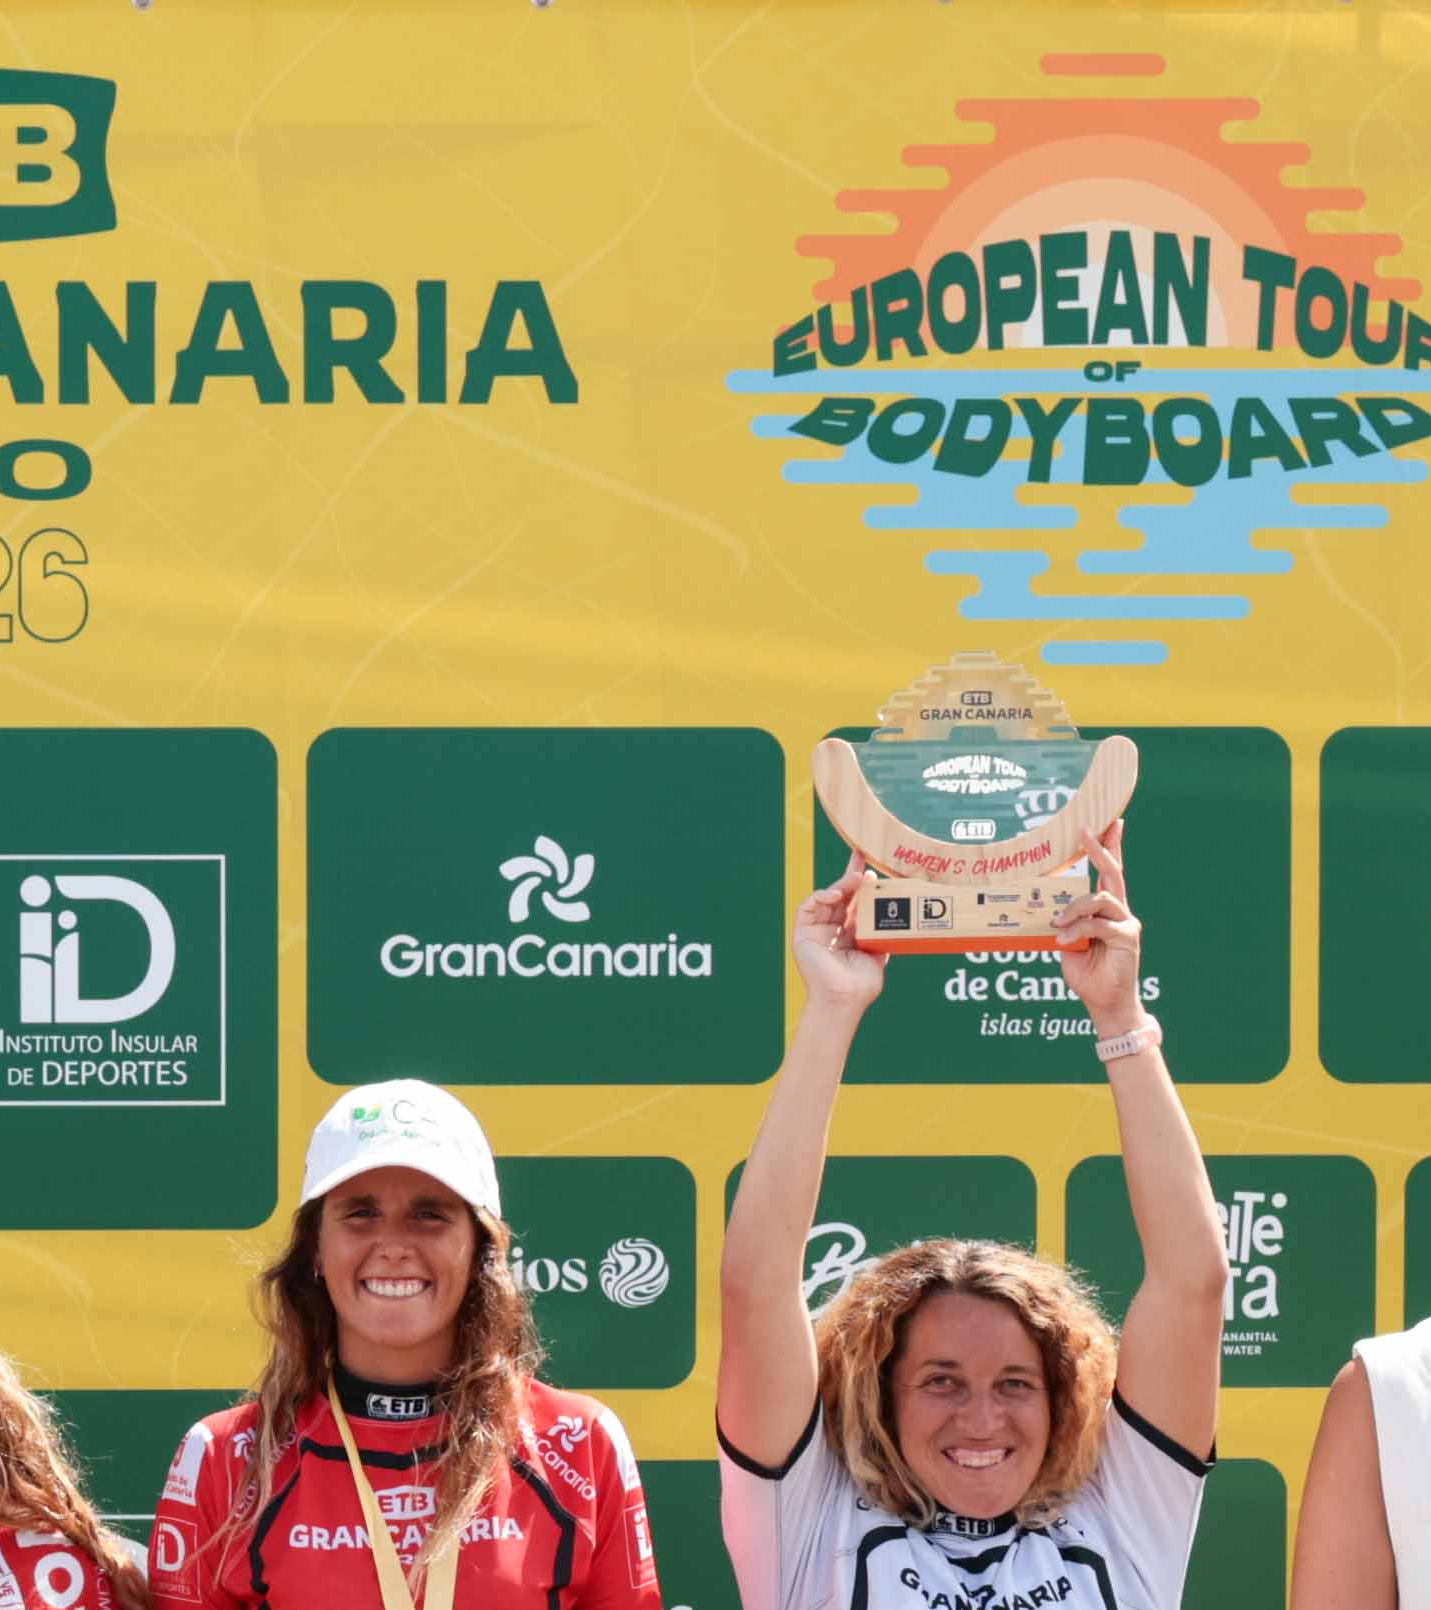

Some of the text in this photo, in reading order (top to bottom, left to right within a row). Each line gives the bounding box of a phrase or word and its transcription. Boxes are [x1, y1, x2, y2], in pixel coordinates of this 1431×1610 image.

[774, 230, 1210, 377] EUROPEAN
[1083, 361, 1142, 382] OF
[920, 708, 1033, 720] GRAN CANARIA
[381, 933, 712, 978] GranCanaria
[7, 1061, 187, 1087] DE DEPORTES
[1222, 1345, 1262, 1355] WATER
[390, 1398, 426, 1415] ETB
[379, 1493, 428, 1512] ETB
[956, 1516, 990, 1534] ETB
